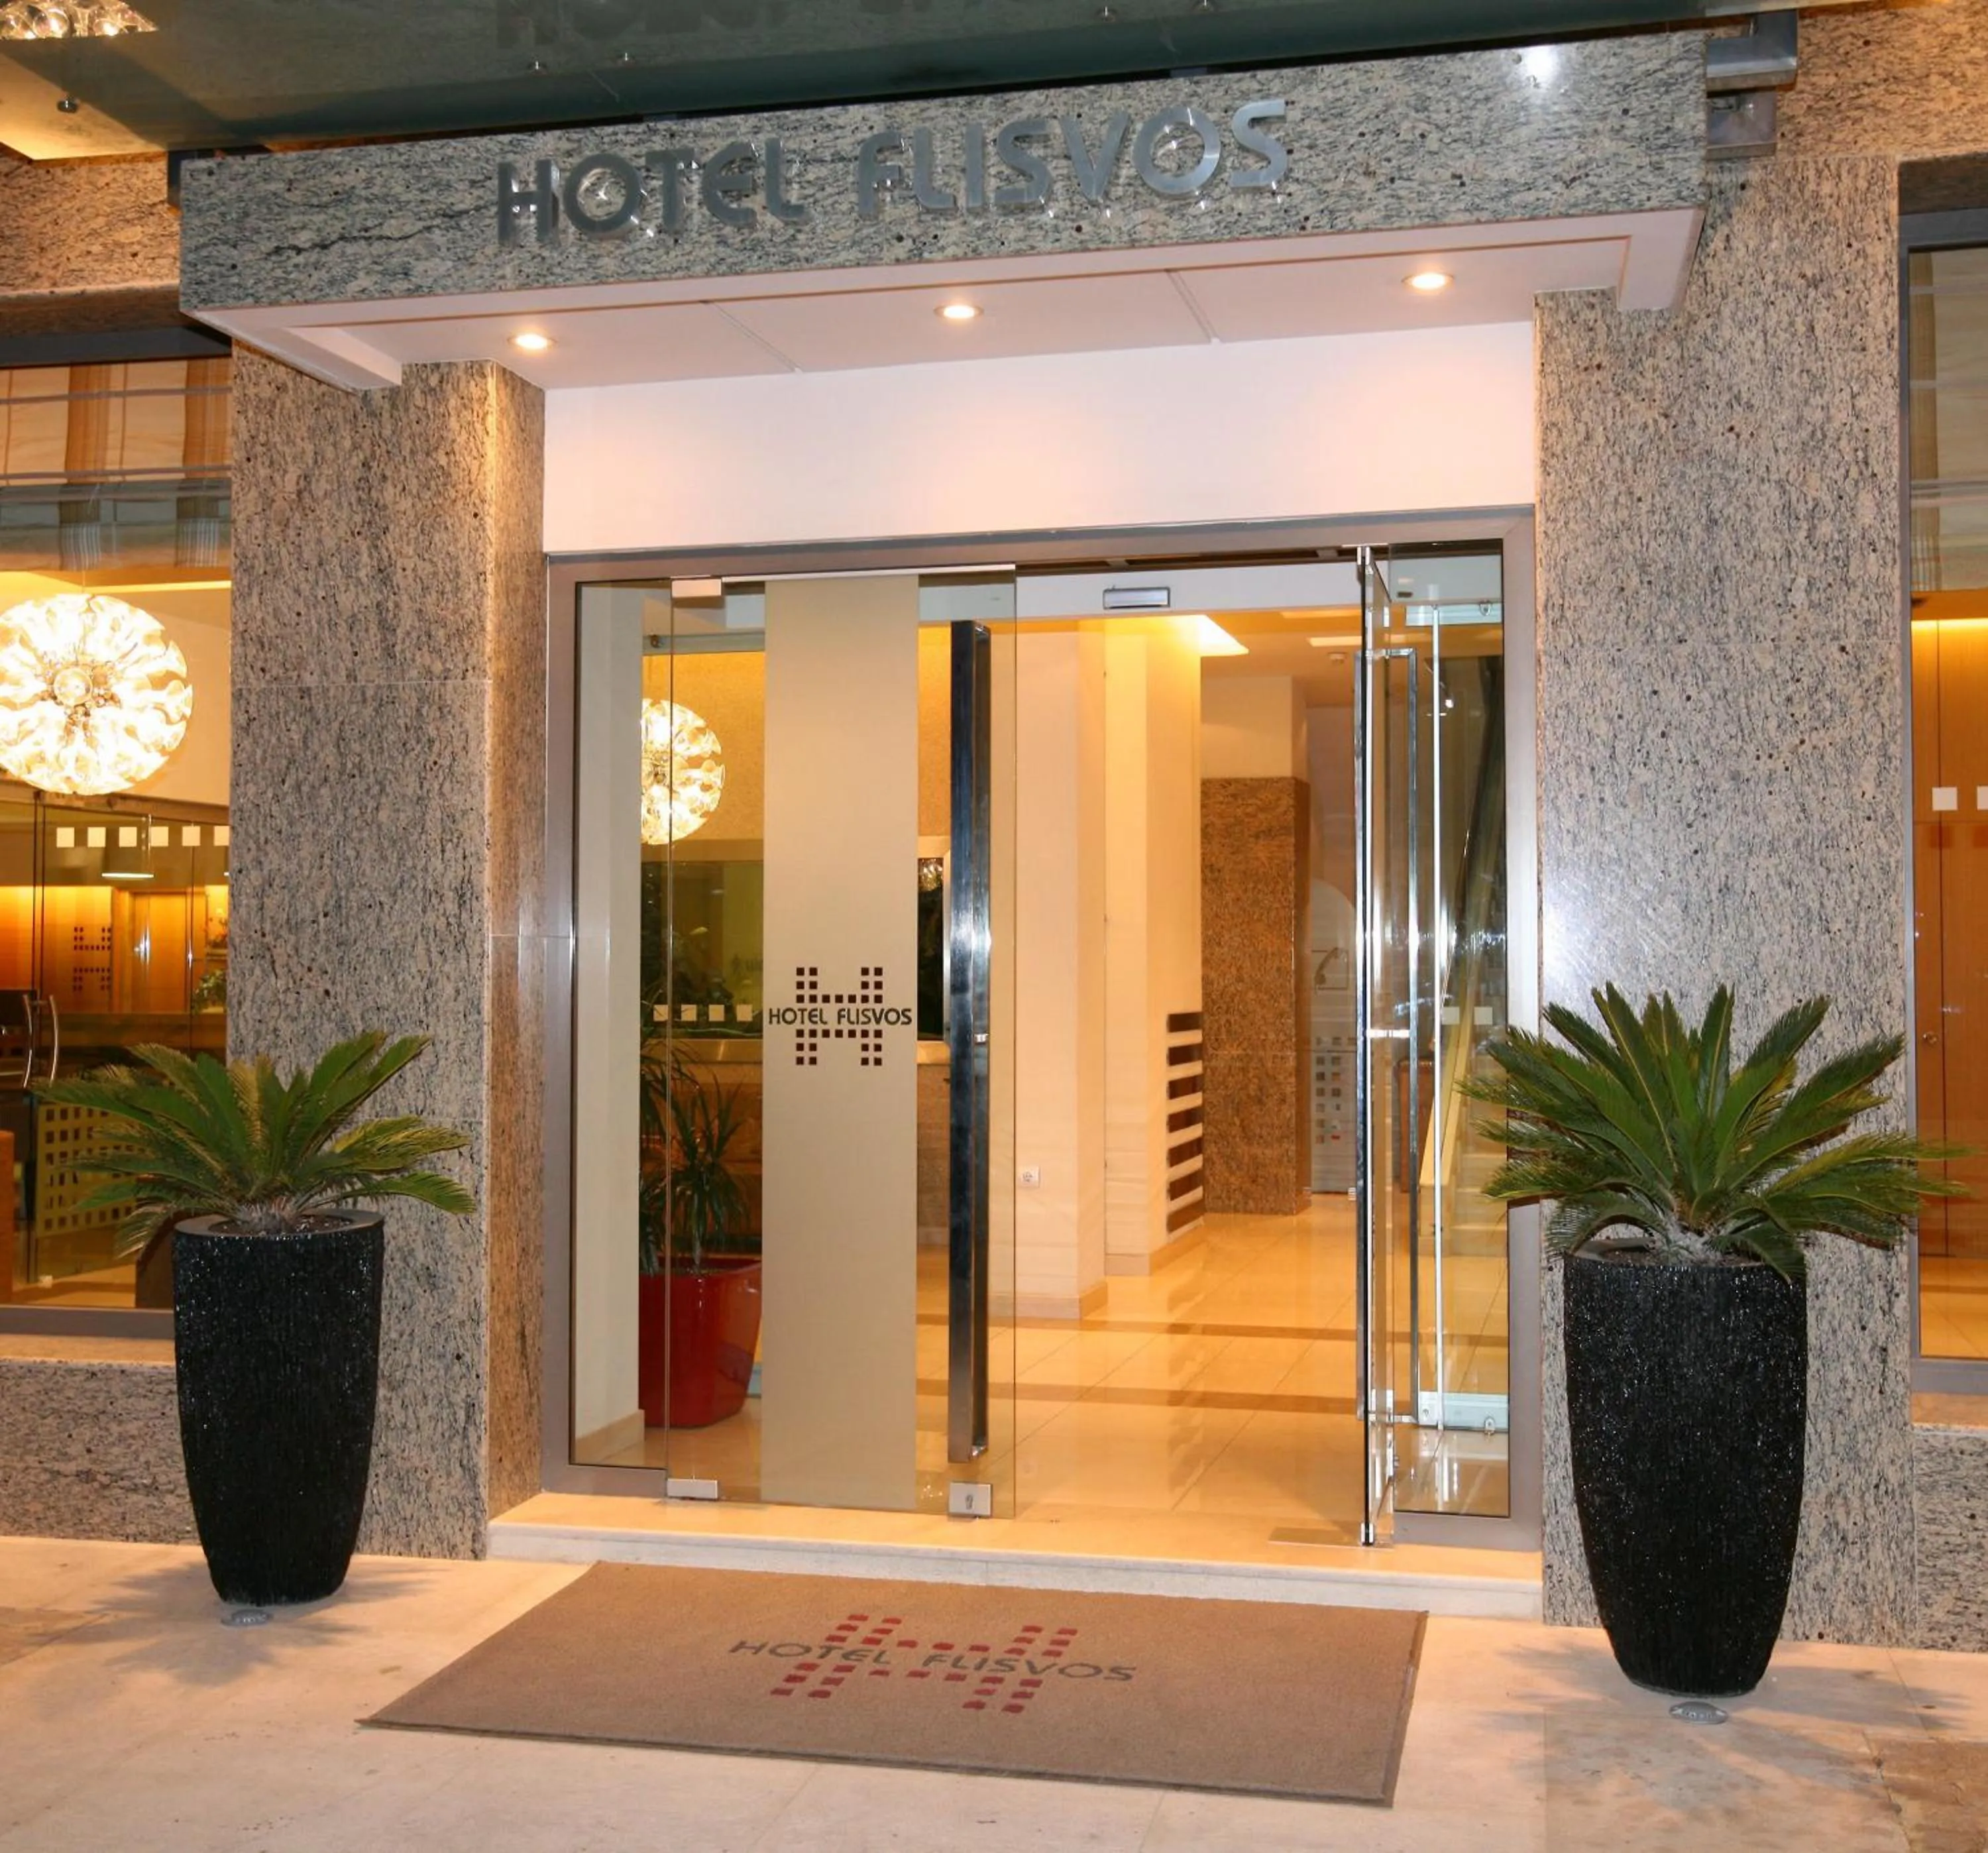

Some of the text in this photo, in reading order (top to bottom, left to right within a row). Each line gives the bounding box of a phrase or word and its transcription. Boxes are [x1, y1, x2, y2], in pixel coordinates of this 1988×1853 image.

[498, 98, 1287, 244] HOTEL FLISVOS
[769, 1007, 912, 1025] HOTEL FLISVOS
[729, 1640, 1136, 1681] HOTEL FLISVOS
